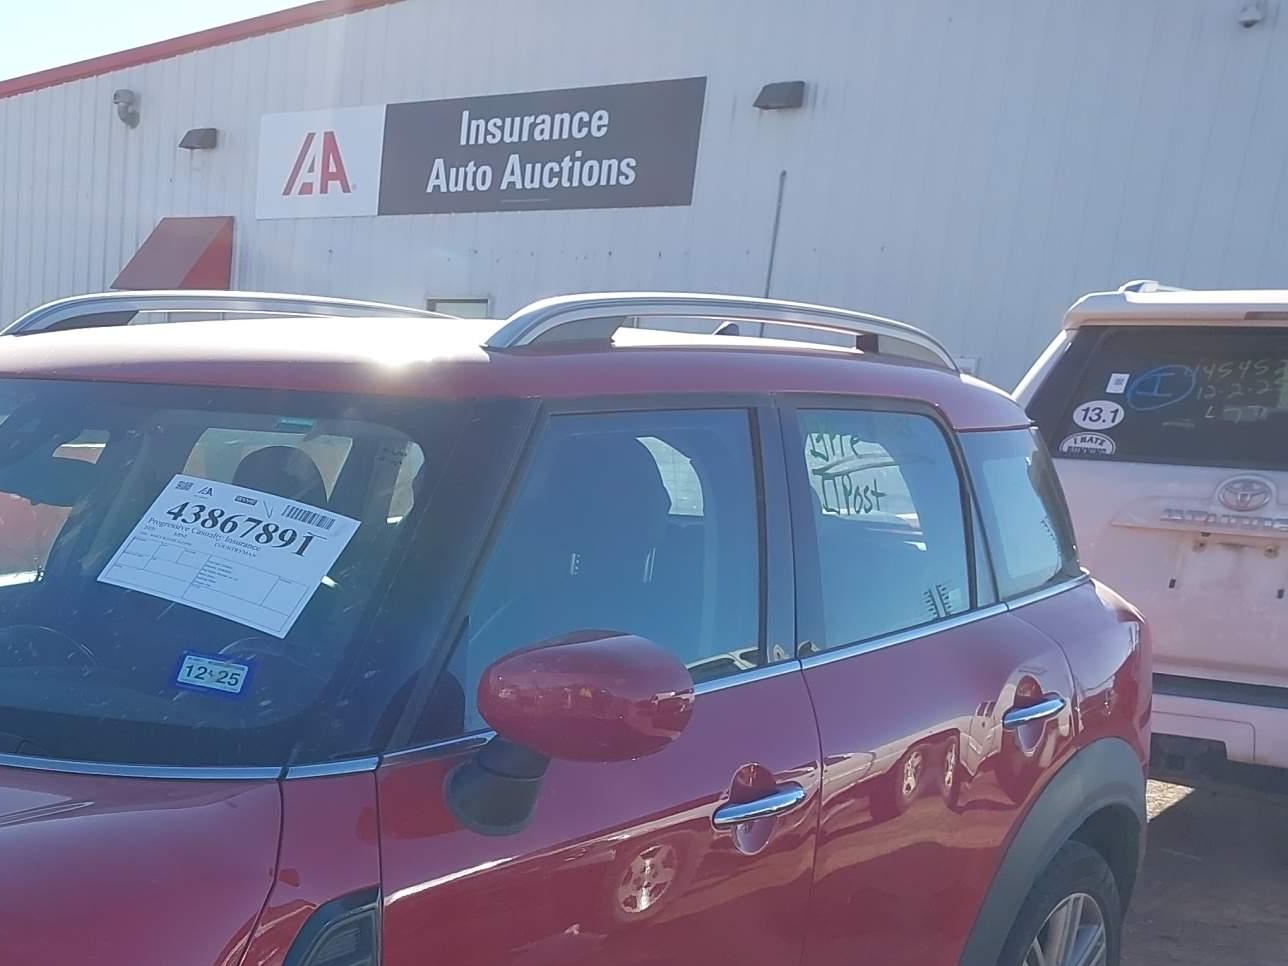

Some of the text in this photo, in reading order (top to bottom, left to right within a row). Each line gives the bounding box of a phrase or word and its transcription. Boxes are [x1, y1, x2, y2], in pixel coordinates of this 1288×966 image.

[458, 108, 610, 147] Insurance
[425, 149, 637, 194] Auto Auctions
[1081, 406, 1120, 424] 13.1
[147, 517, 190, 532] Progressive
[225, 535, 262, 552] Insurance
[166, 502, 317, 557] 43867891
